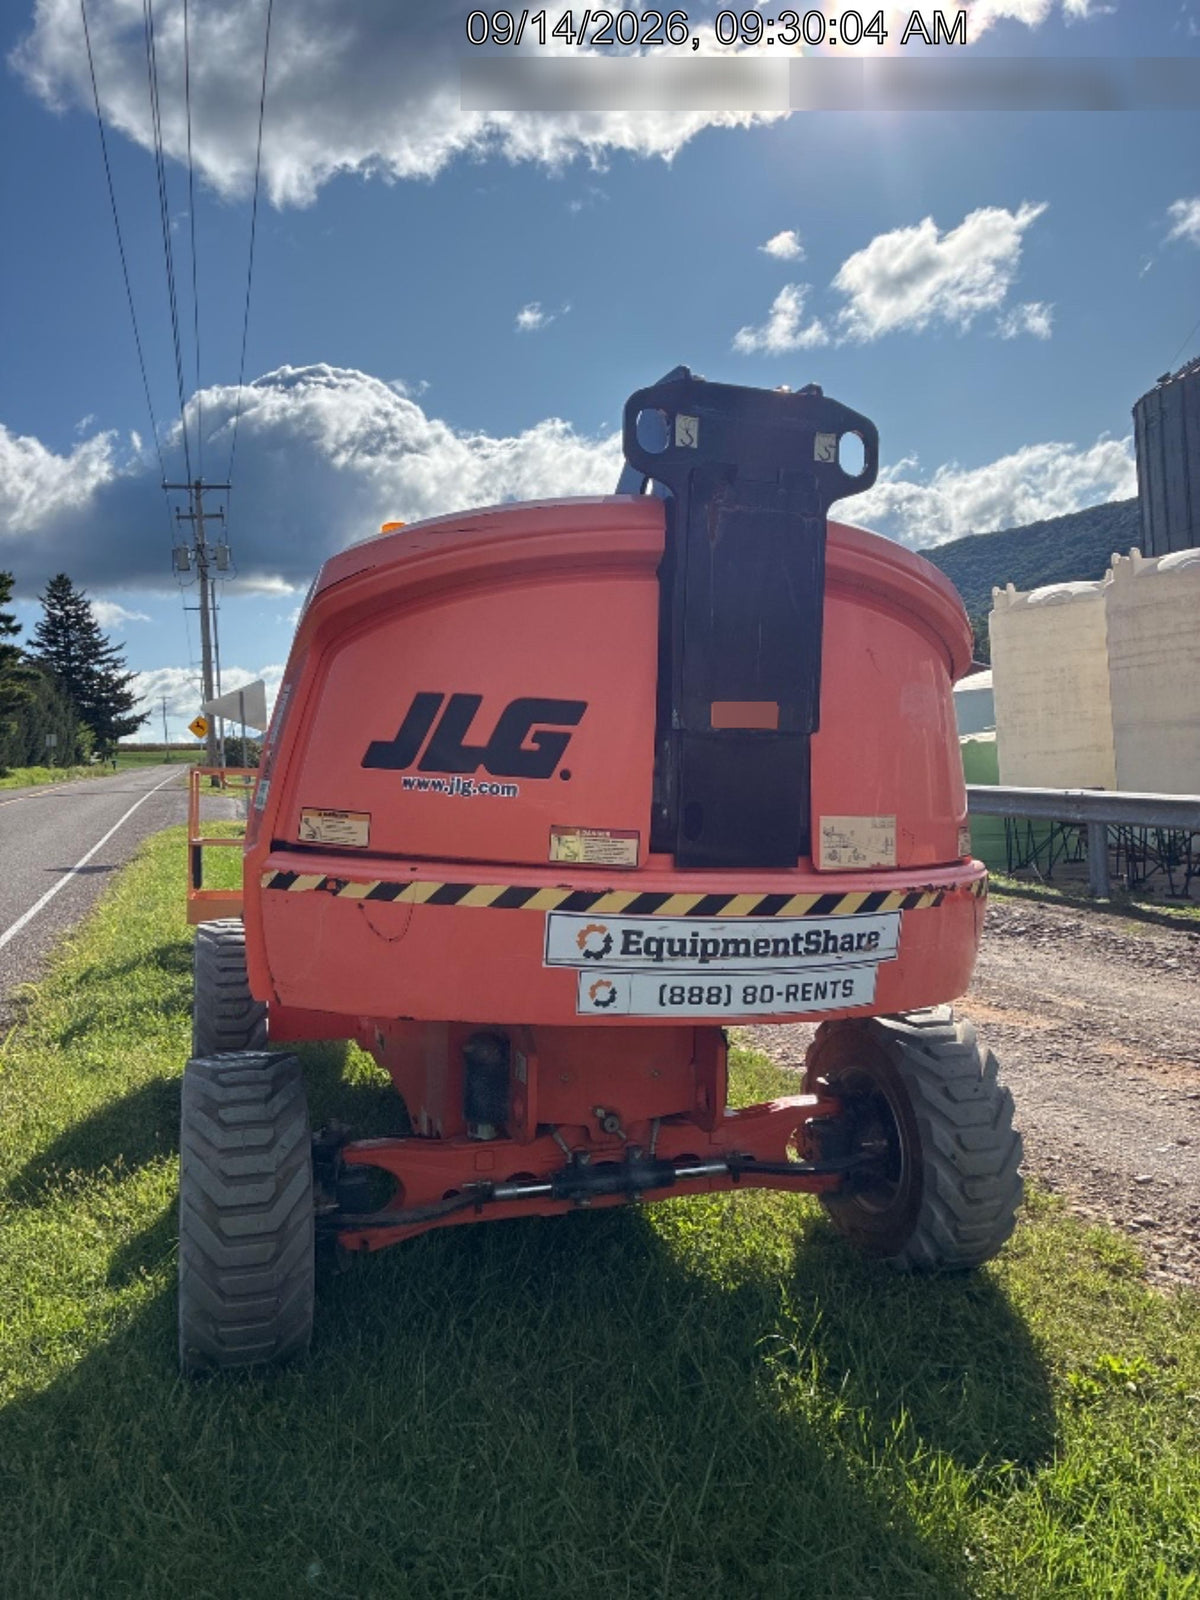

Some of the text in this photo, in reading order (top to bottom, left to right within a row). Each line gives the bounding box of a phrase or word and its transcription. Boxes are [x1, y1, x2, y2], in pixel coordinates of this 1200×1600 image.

[402, 777, 518, 797] www.jlg.com
[620, 929, 880, 963] EquipmentShare
[659, 979, 854, 1007] (888) 80-RENTS
